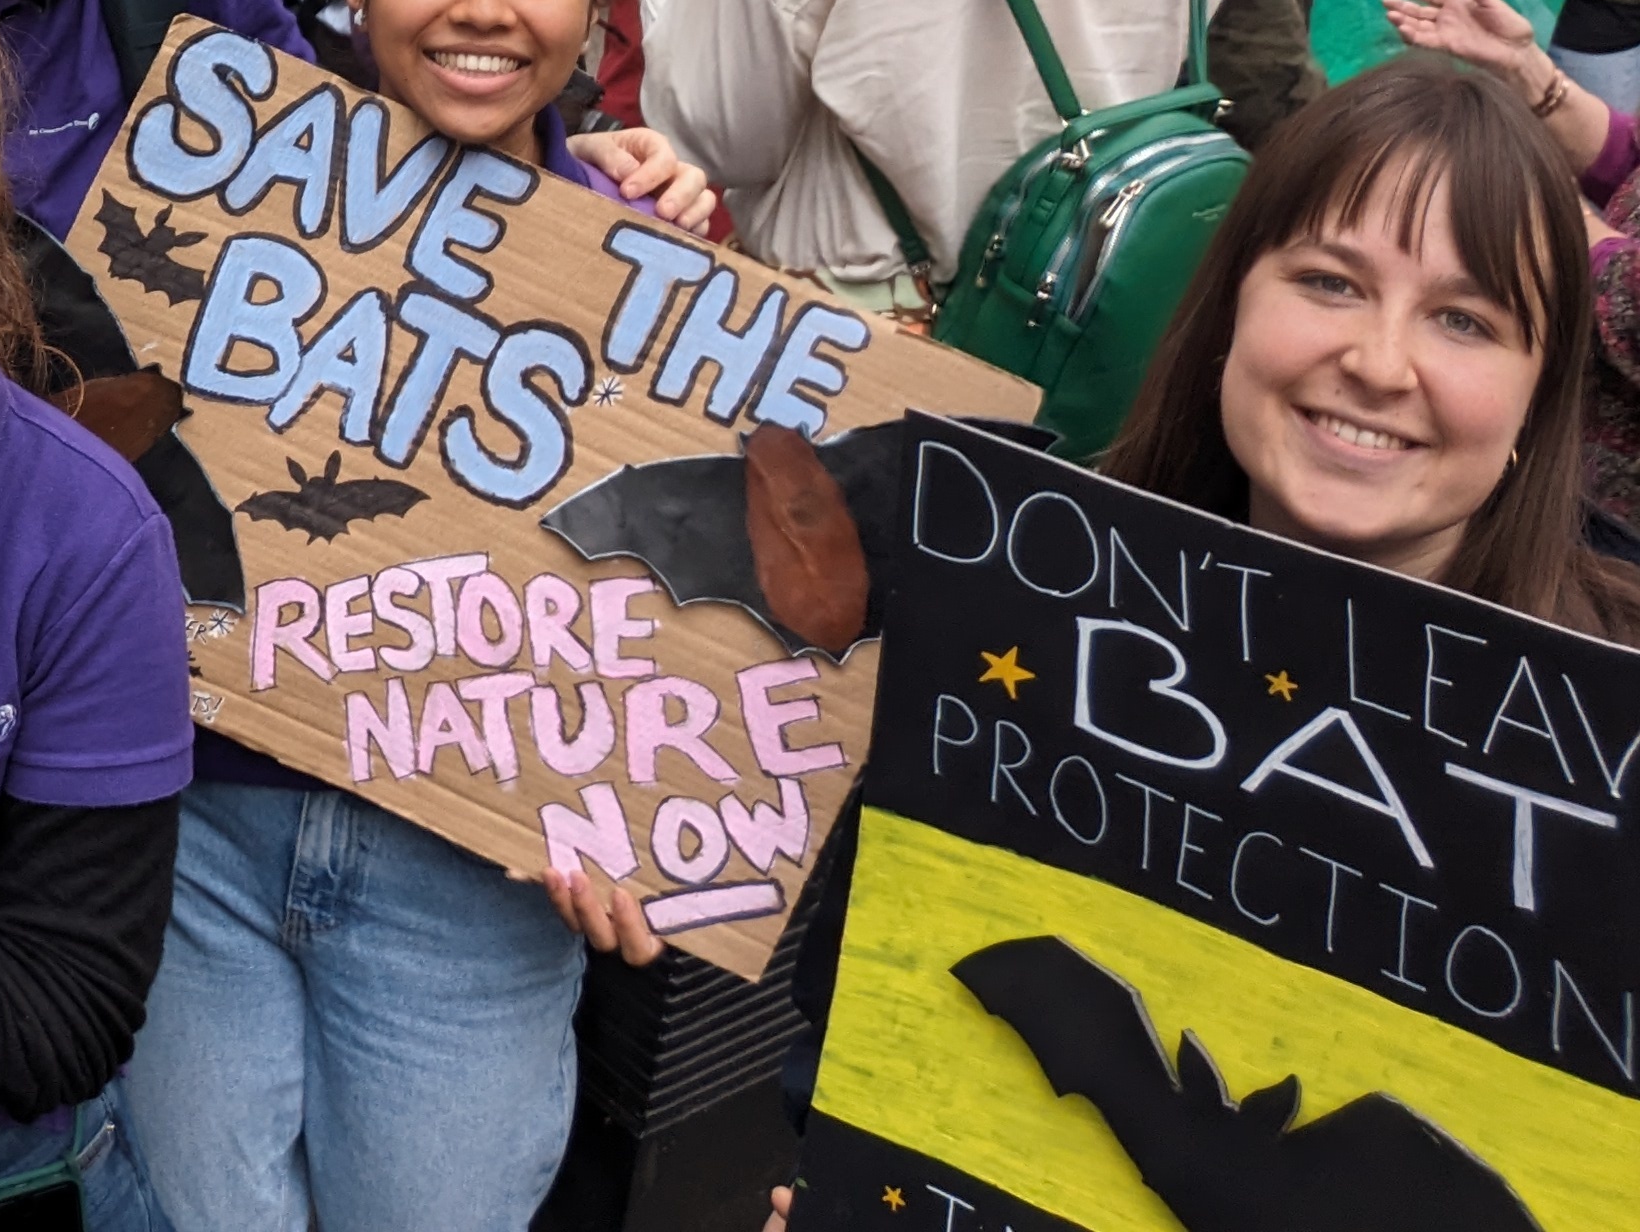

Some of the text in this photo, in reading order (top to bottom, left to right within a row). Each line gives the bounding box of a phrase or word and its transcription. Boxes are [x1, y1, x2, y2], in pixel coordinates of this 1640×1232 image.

[129, 28, 871, 438] SAVE THE
[185, 234, 595, 508] BATS
[251, 551, 659, 692] RESTORE
[344, 657, 851, 786] NATURE
[913, 440, 1640, 799] DON'T LEAV
[538, 777, 811, 887] NOW
[932, 693, 1637, 1082] PROTECTION
[1073, 616, 1618, 912] BAT
